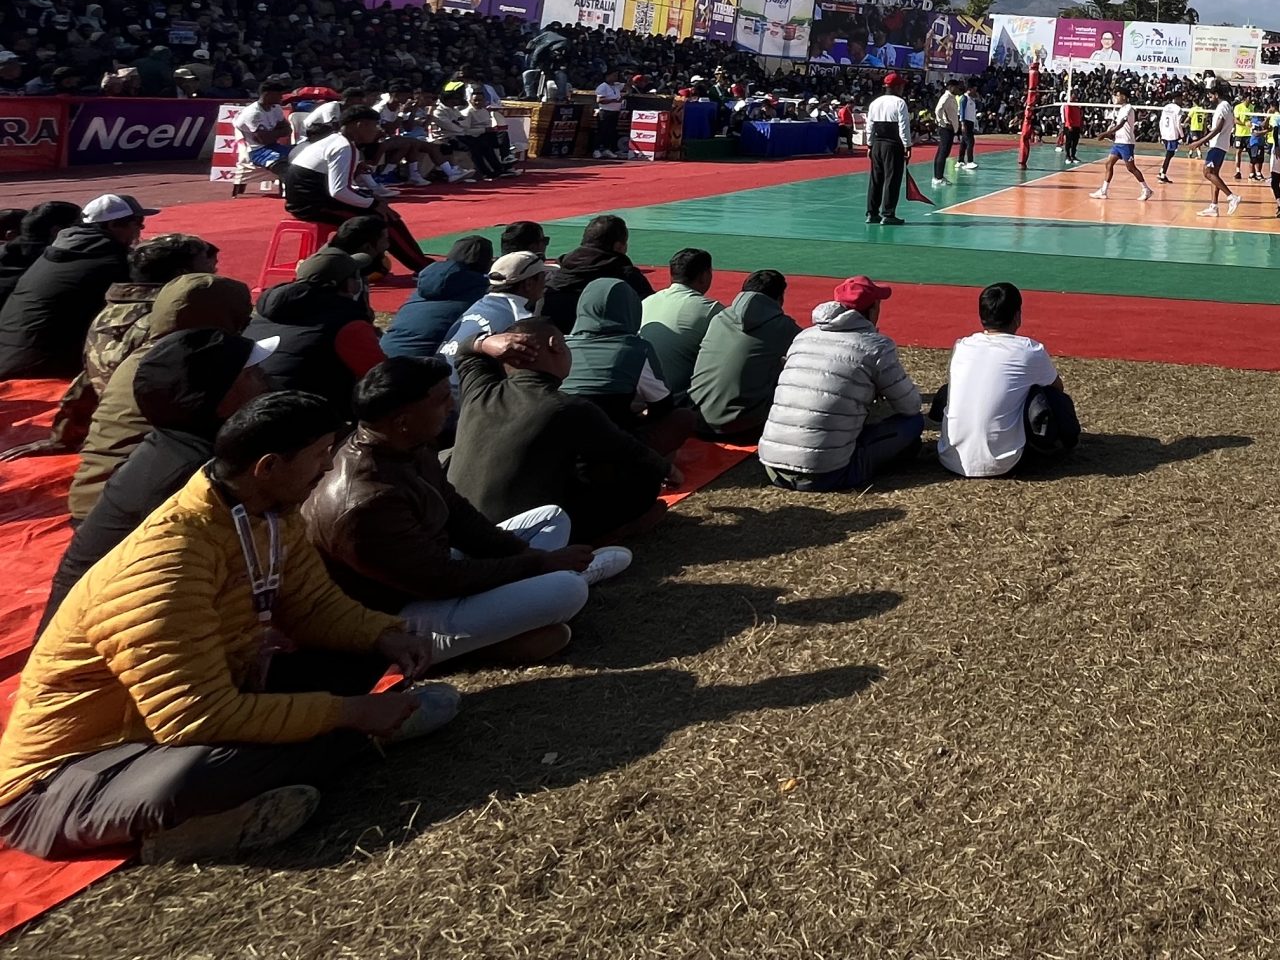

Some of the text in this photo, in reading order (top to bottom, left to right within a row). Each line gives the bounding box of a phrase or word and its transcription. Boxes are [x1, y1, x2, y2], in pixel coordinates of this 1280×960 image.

[956, 31, 991, 45] XTREME
[1146, 35, 1187, 48] Franklin
[1136, 54, 1180, 64] AUSTRALIA
[77, 116, 204, 152] Ncell
